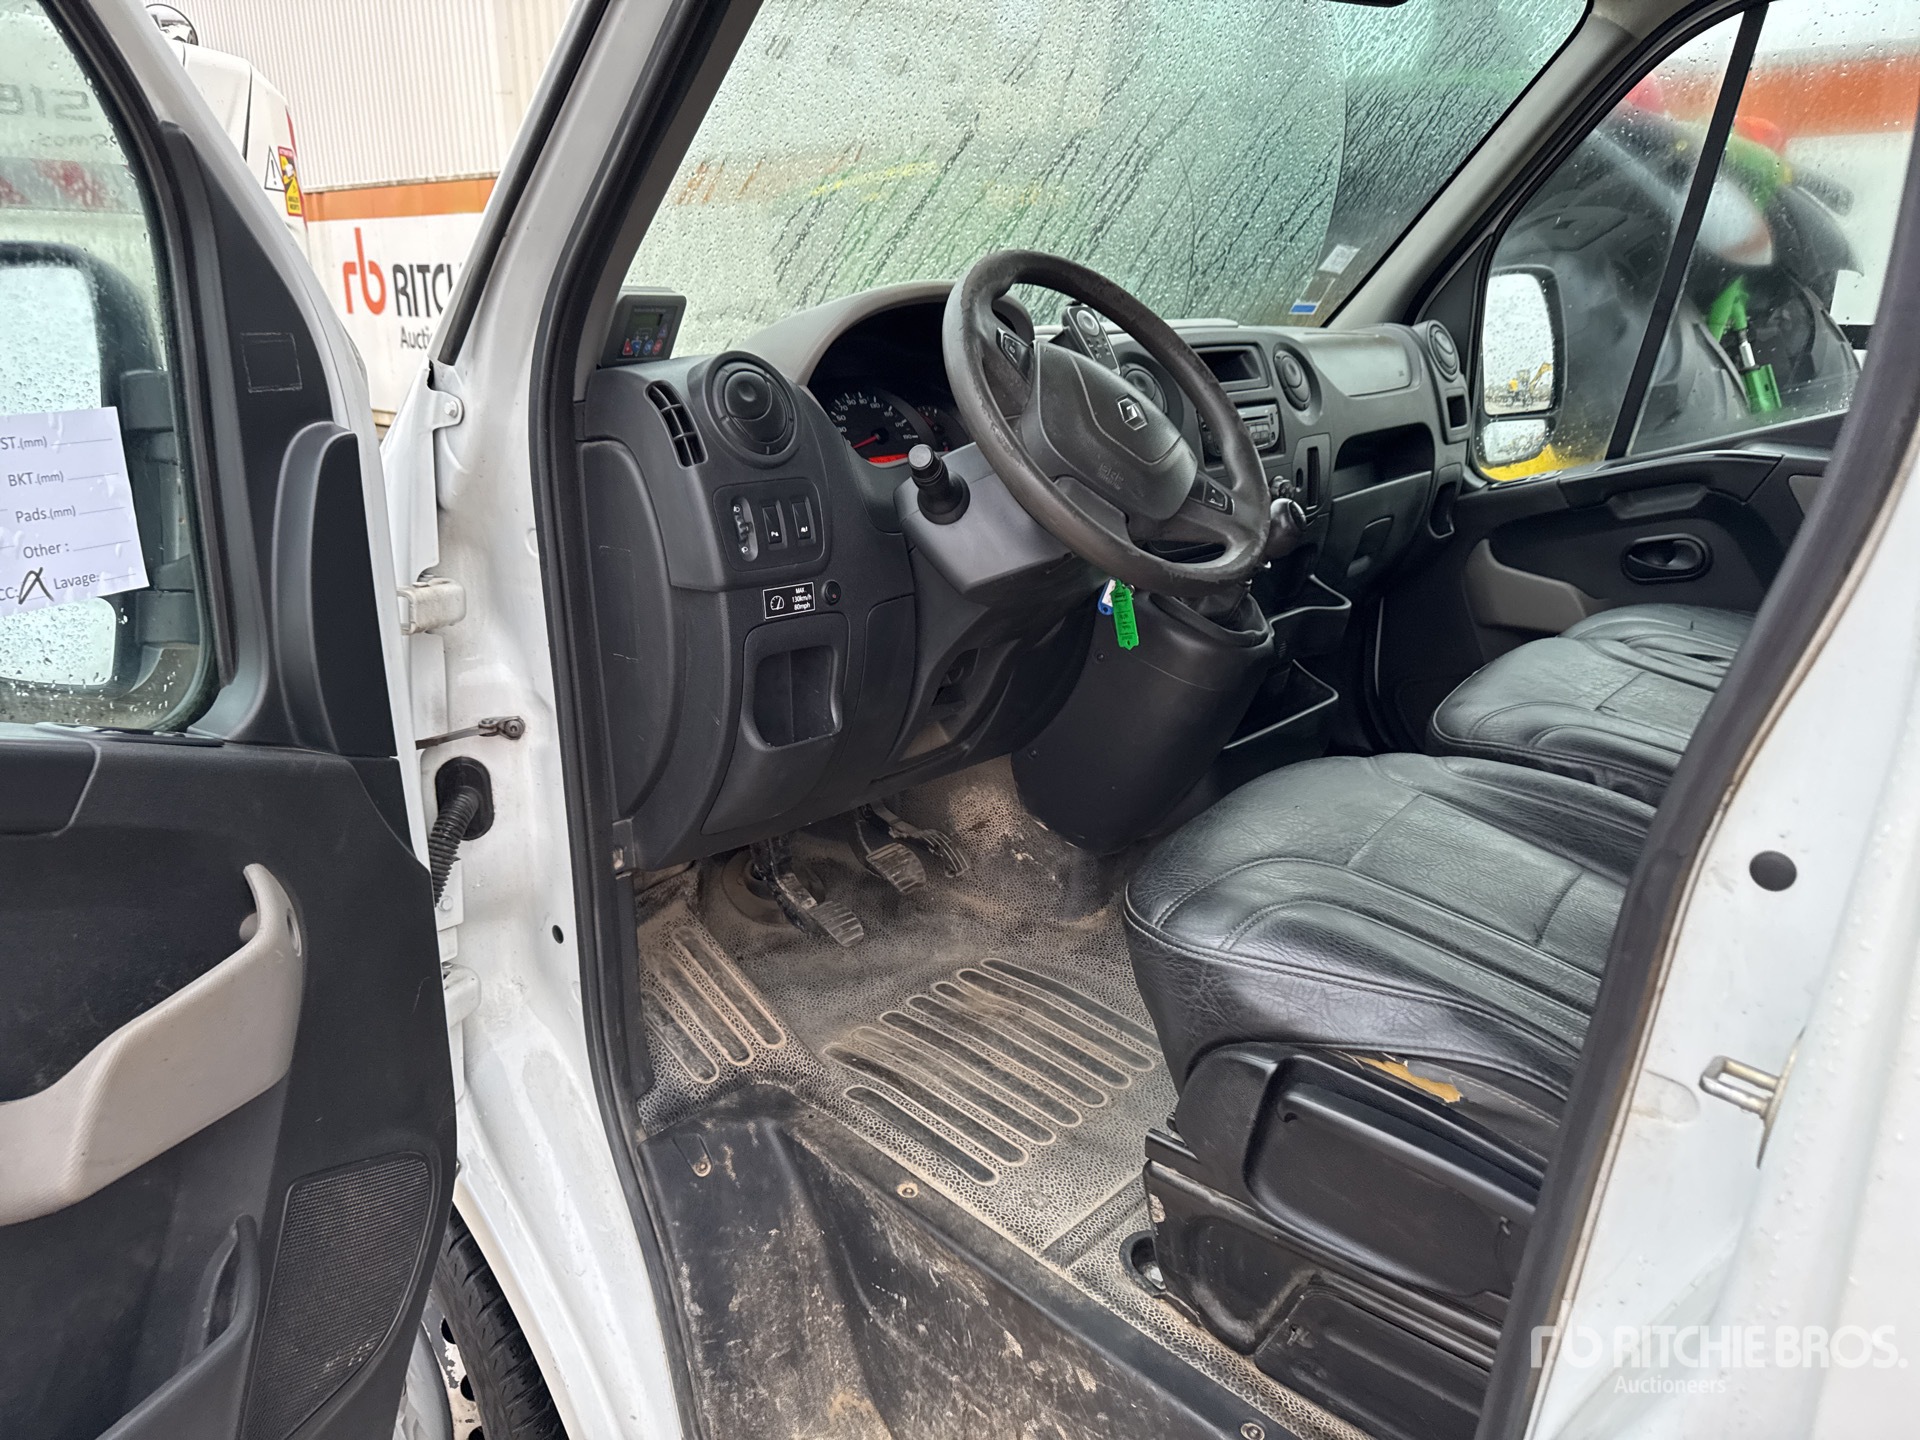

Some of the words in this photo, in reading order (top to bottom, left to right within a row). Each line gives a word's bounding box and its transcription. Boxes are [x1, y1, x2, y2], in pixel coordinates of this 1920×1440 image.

[400, 325, 433, 350] Aucti
[8, 470, 64, 487] BKT.(mm)
[15, 505, 77, 523] Pads.(mm)
[23, 544, 62, 559] Other
[53, 572, 101, 590] Lavage:
